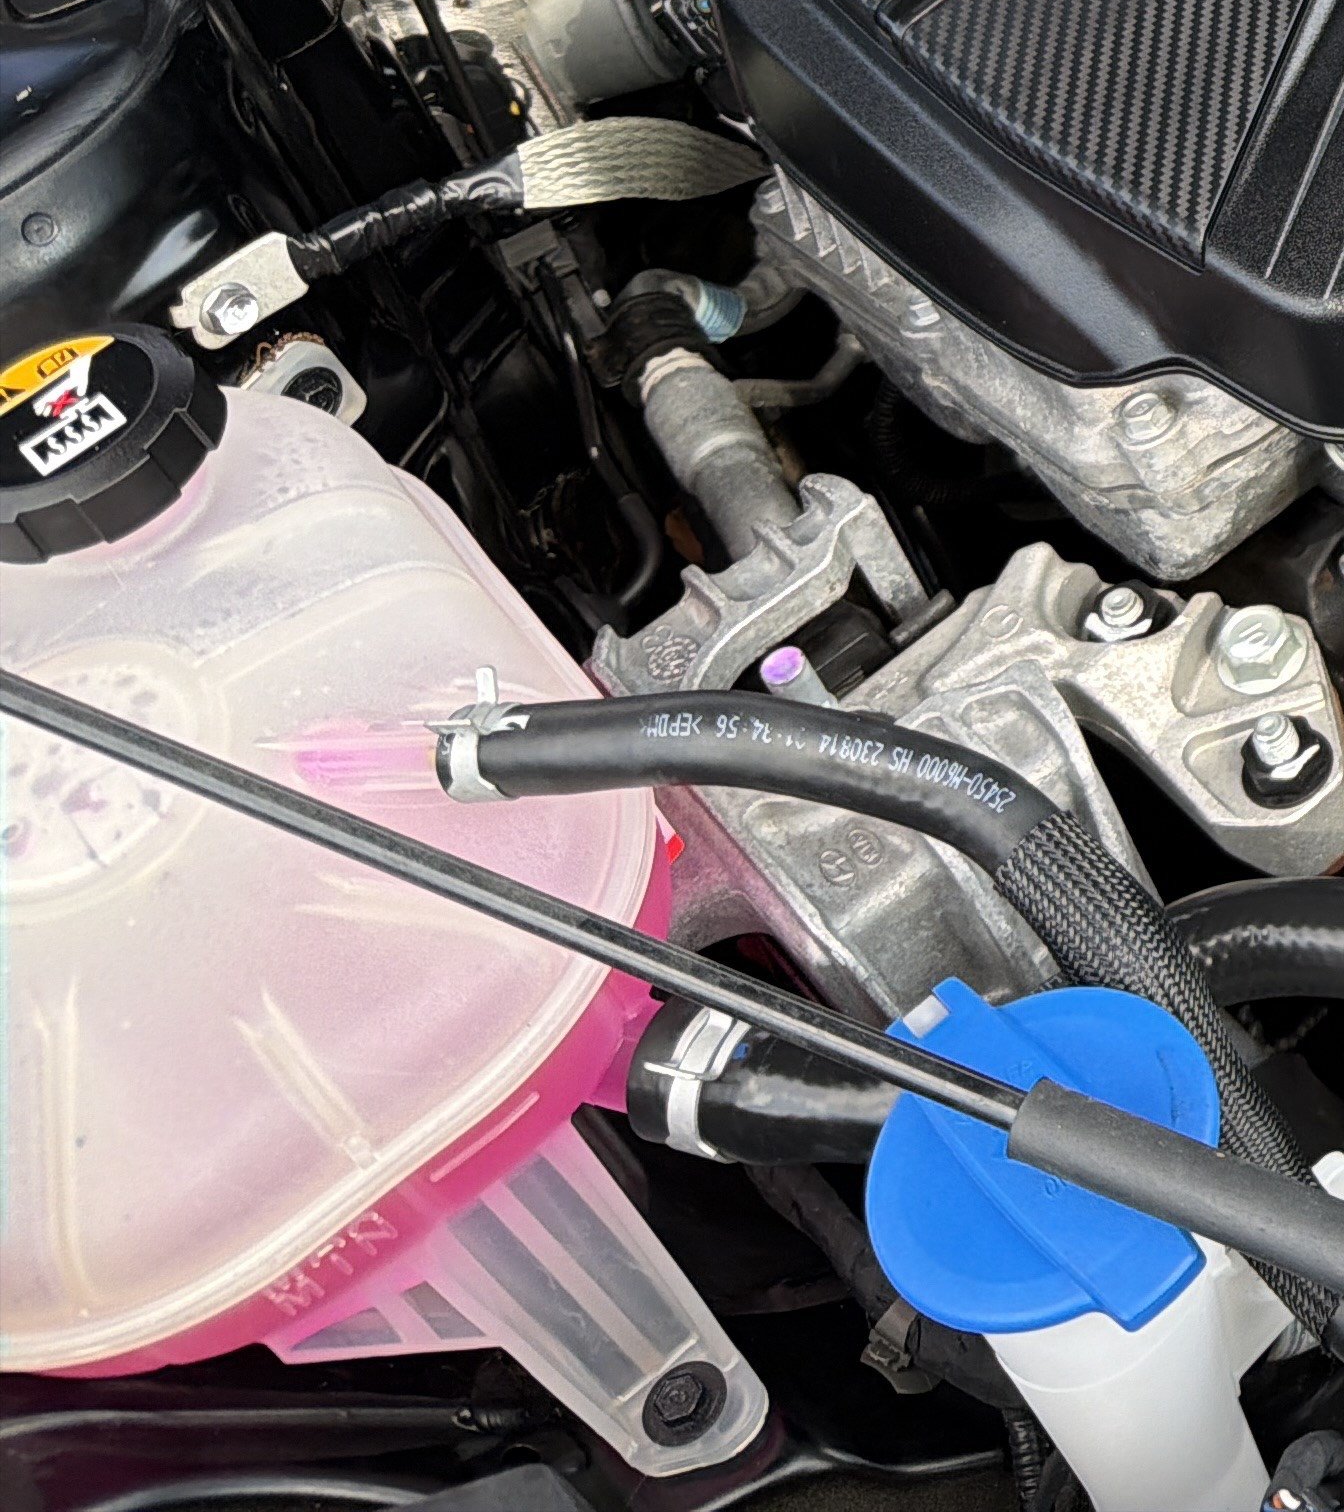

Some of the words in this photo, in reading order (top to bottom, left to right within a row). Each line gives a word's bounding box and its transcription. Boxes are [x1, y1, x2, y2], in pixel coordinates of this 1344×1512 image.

[818, 733, 885, 767] 230814
[887, 746, 914, 774] HS
[916, 753, 1017, 814] 25450-M6000
